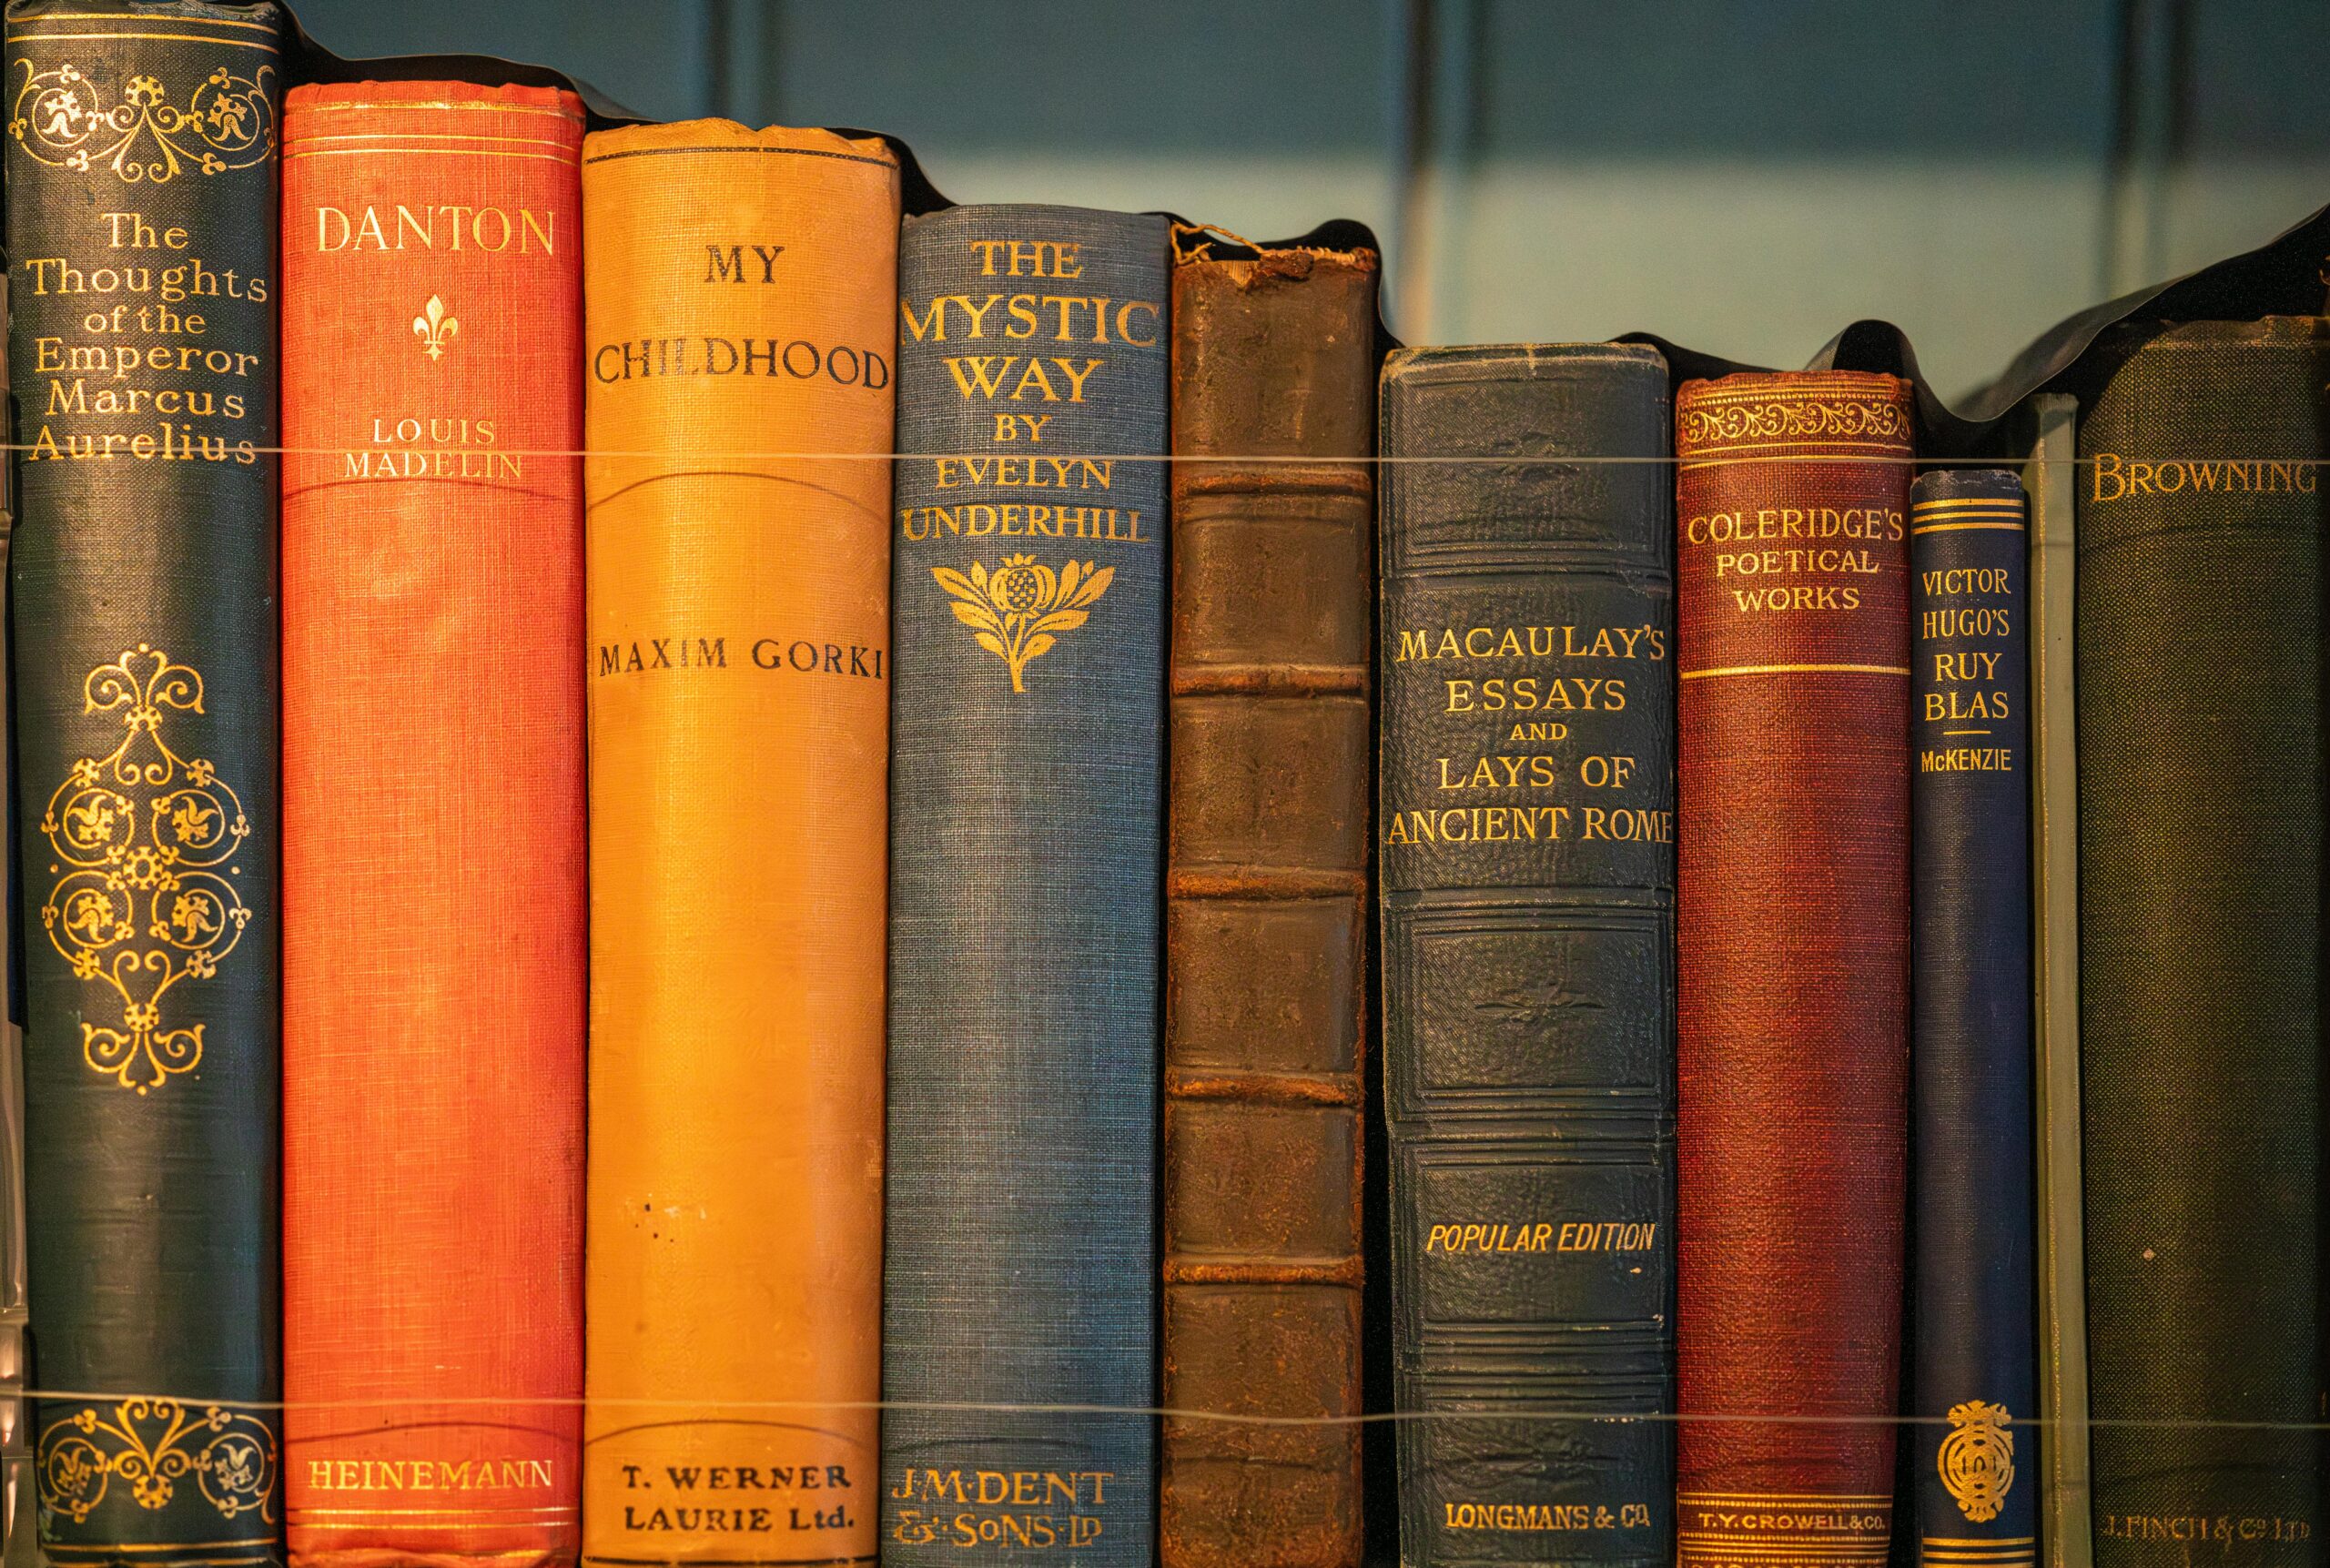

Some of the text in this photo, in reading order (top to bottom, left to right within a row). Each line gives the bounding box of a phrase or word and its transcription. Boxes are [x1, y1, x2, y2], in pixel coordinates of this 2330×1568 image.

[100, 213, 188, 249] The
[316, 205, 555, 256] DANTON
[704, 245, 785, 283] MY
[970, 240, 1082, 279] THE
[25, 258, 268, 302] Thoughts
[84, 306, 207, 335] of the
[901, 295, 1160, 347] MYSTIC
[35, 338, 259, 377] Emperor
[593, 338, 888, 389] CHILDHOOD
[943, 357, 1104, 402] WAY
[45, 379, 246, 419] Marcus
[28, 423, 256, 465] Aurelius
[373, 419, 495, 444] LOUIS
[993, 414, 1052, 442] BY
[344, 451, 522, 478] MADELIN
[935, 459, 1114, 491] EVELYN
[901, 506, 1150, 544] UNDERHILL
[1687, 509, 1904, 545] COLERIDGE'S
[1716, 550, 1879, 577] POETICAL
[1922, 569, 2011, 595] VICTOR
[1734, 587, 1860, 612] WORKS
[1922, 609, 2010, 639] HUGO'S
[599, 637, 883, 680] MAXIM GORKI
[1395, 624, 1665, 662] MACAULAY'S
[1934, 652, 2002, 681] RUY
[1444, 679, 1626, 712] ESSAYS
[1924, 692, 2009, 721] BLAS
[1509, 723, 1567, 740] AND
[1436, 756, 1636, 790] LAYS OF
[1921, 749, 2011, 773] McKENZIE
[1387, 807, 1673, 845] ANCIENT ROME
[1426, 1223, 1656, 1251] POPULAR EDITION
[308, 1460, 552, 1491] HEINEMANN
[623, 1466, 851, 1490] T. WERNER
[623, 1507, 855, 1531] LAURIE Ltd.
[1445, 1503, 1589, 1530] LONGMANS
[1593, 1506, 1615, 1529] &
[2214, 1517, 2234, 1544] &
